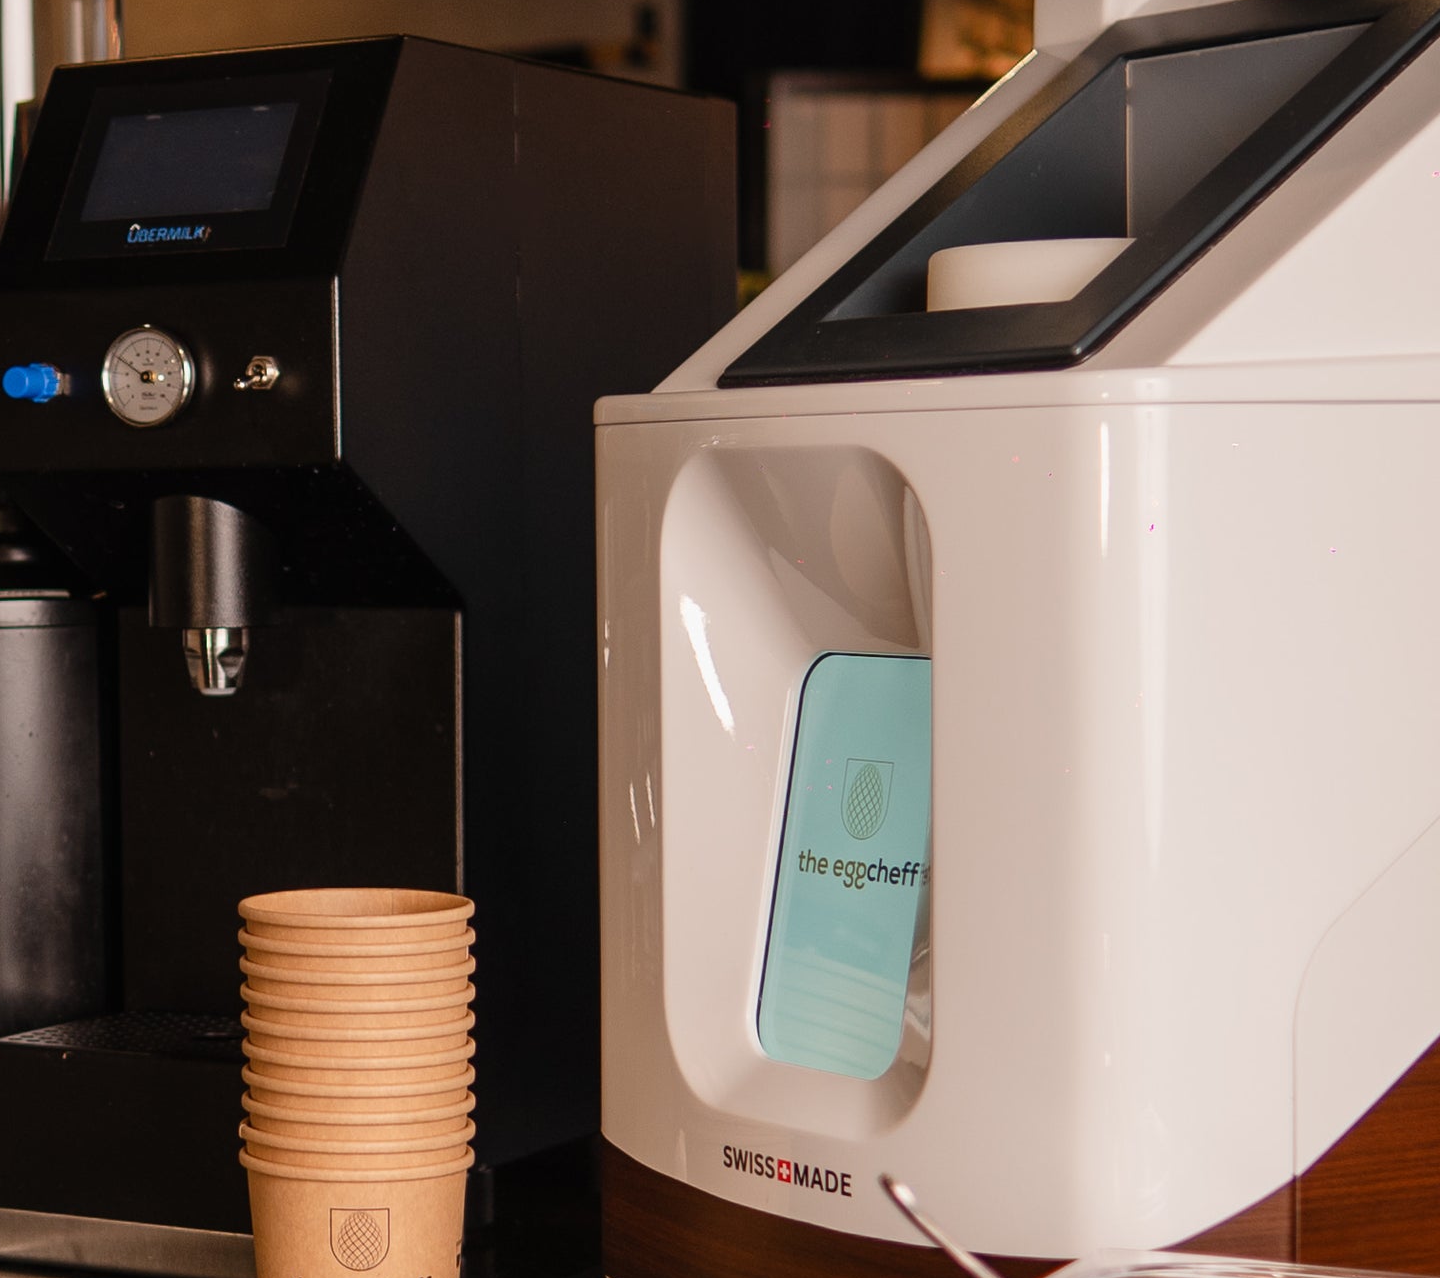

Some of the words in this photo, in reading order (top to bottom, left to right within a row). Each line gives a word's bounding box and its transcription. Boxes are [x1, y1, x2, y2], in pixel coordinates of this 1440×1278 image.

[798, 849, 829, 875] the
[832, 857, 921, 890] eggcheff
[723, 1145, 776, 1179] SWISS
[793, 1162, 852, 1198] MADE
